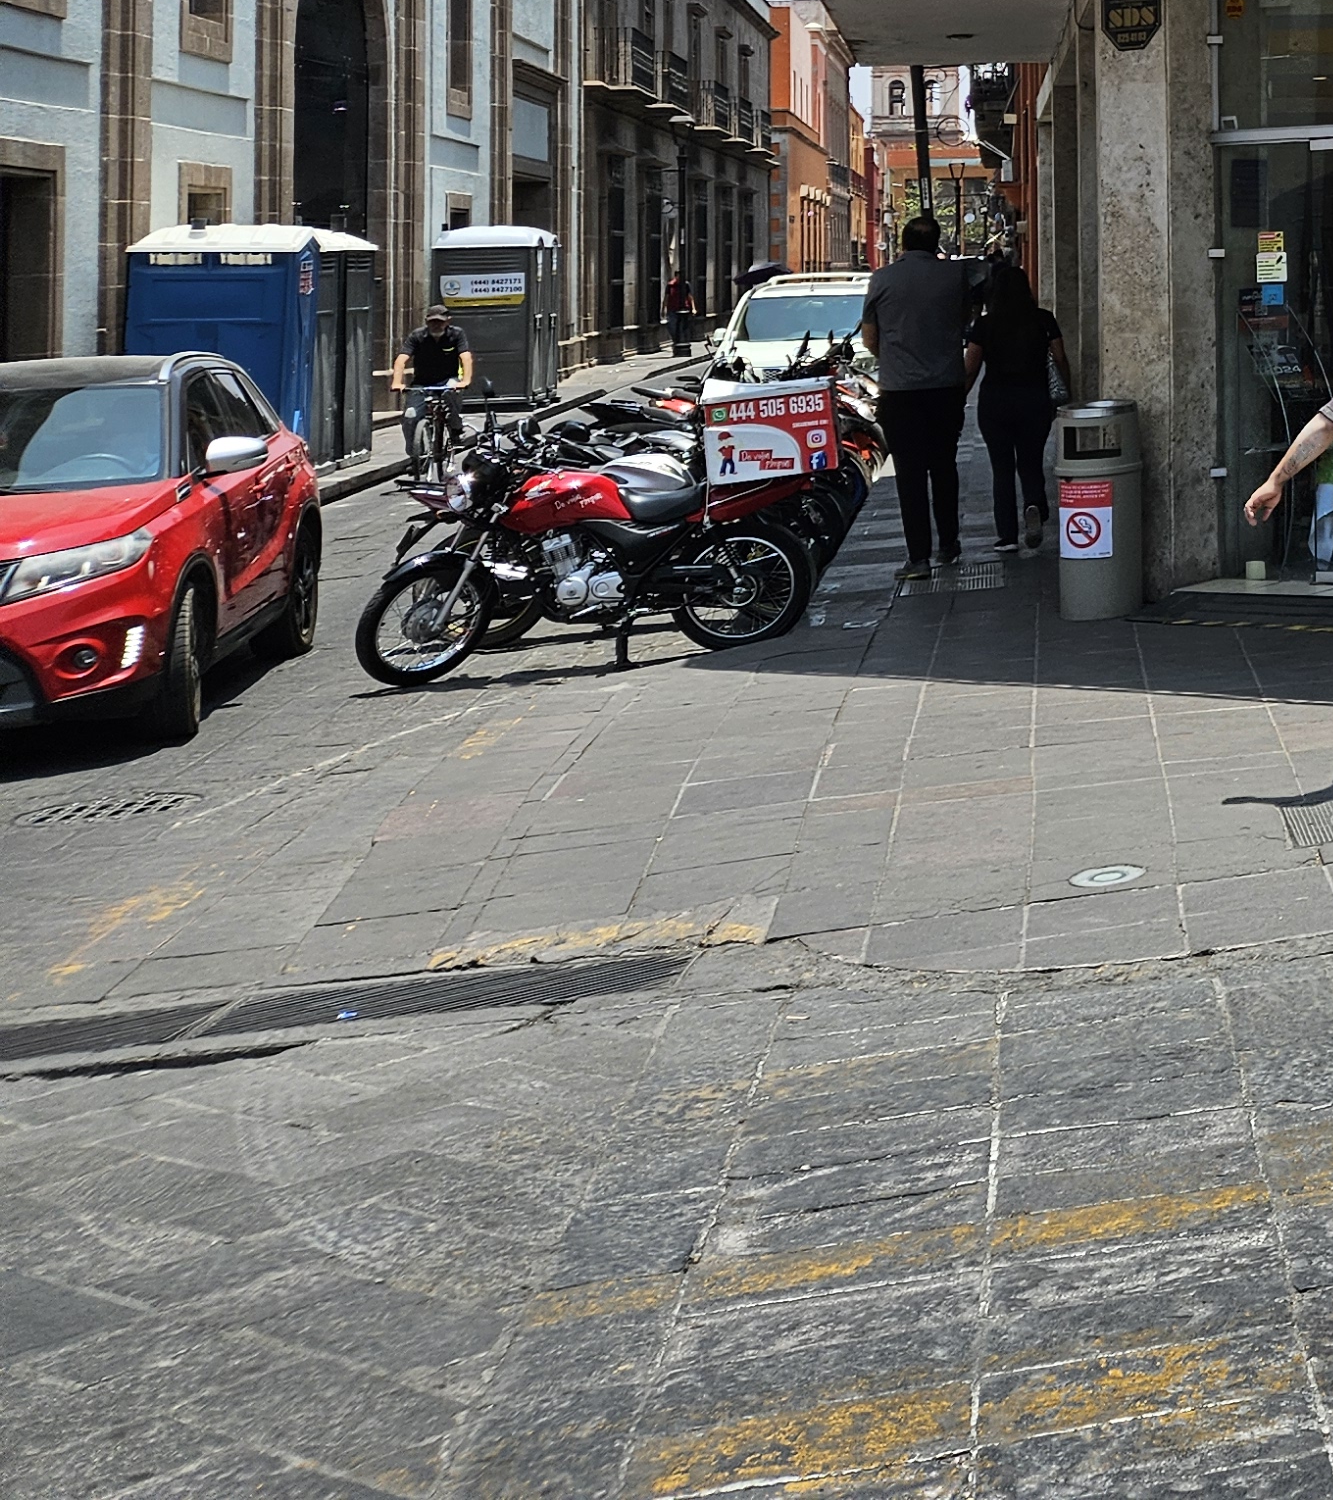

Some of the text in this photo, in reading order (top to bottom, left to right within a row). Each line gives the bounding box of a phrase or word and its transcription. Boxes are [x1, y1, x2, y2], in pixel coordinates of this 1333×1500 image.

[1109, 6, 1156, 28] SDS
[729, 393, 824, 421] 444 505 6935
